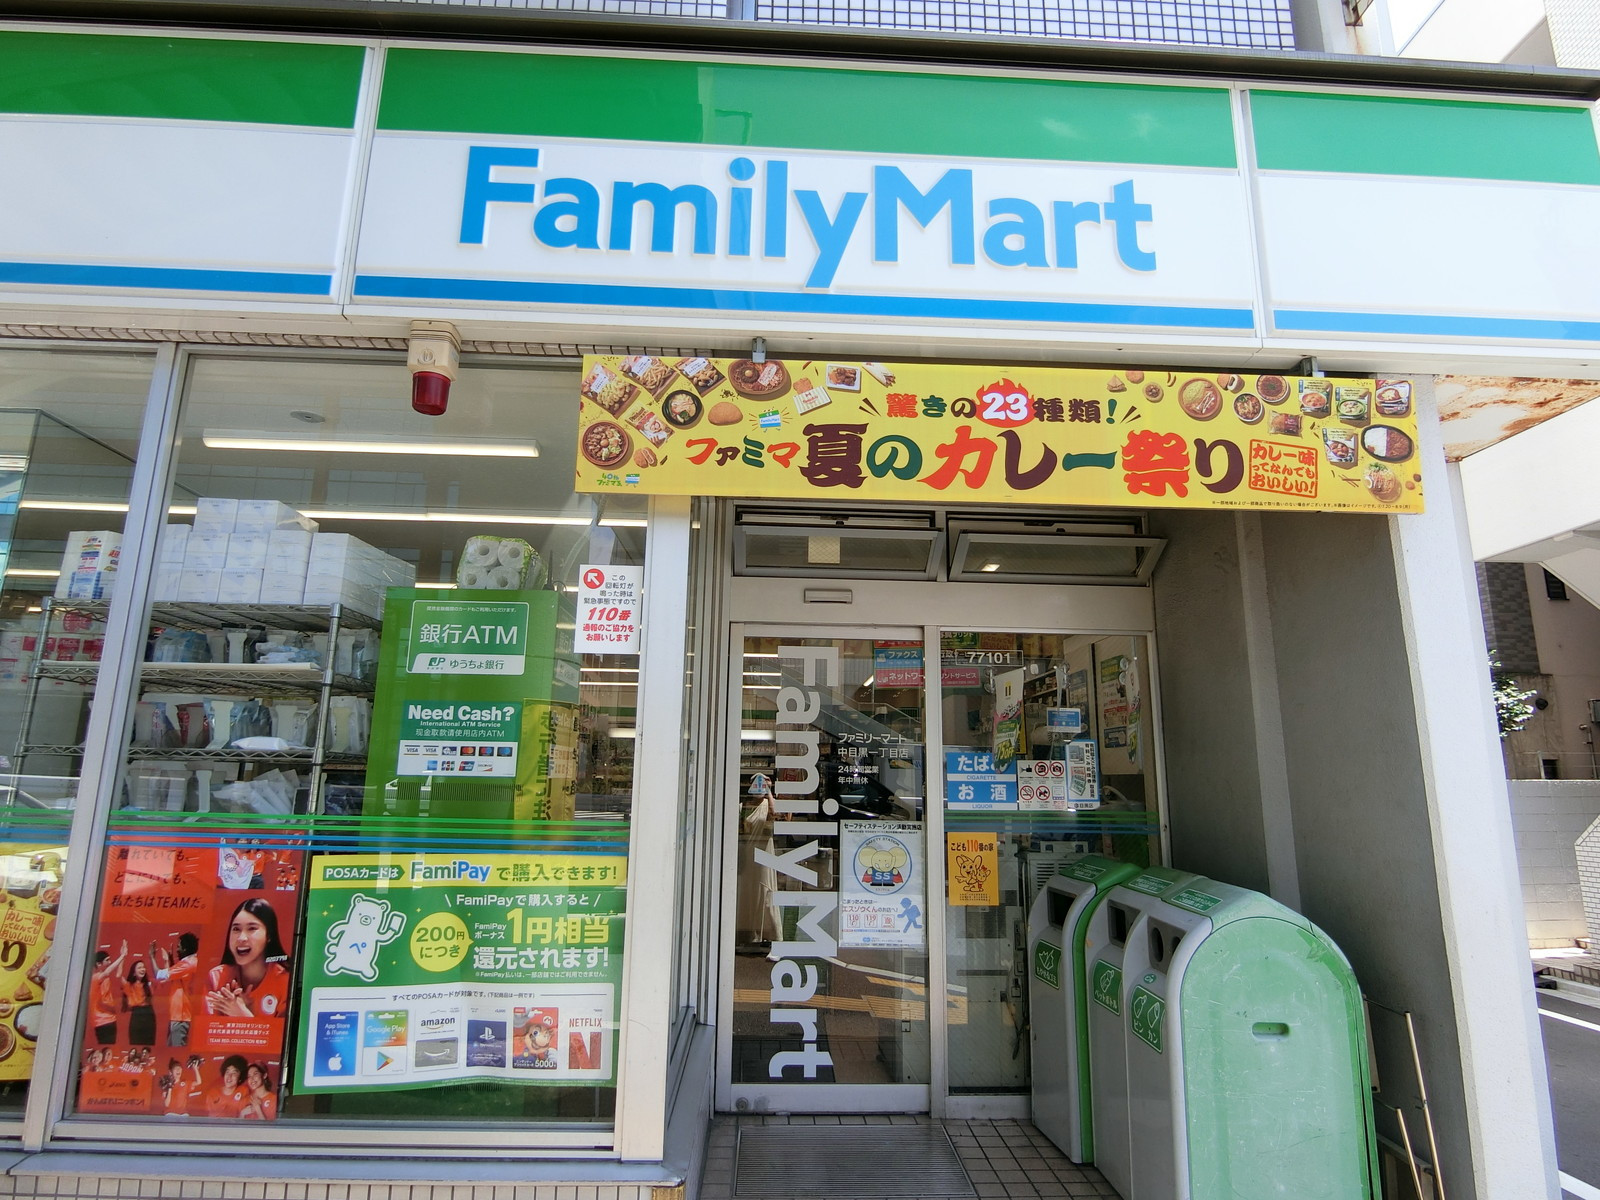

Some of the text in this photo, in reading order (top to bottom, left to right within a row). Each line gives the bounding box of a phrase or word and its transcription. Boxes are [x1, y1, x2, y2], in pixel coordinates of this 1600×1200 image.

[459, 145, 1157, 289] FamilyMart
[886, 391, 1117, 424] 驚きの23種類!
[1252, 443, 1315, 467] カレー味
[1252, 463, 1315, 480] ってなんでも
[1251, 473, 1315, 494] おいしい!
[588, 608, 632, 621] 110番
[420, 624, 518, 645] 銀行ATM
[586, 634, 630, 642] お願いします
[449, 660, 505, 670] ゆうちょ銀行
[967, 652, 1010, 664] 77101
[408, 704, 514, 721] Need Cash?
[838, 733, 907, 744] ファミリーマート
[838, 747, 909, 758] 中目黒一丁目店
[754, 646, 839, 1078] FamilyMart
[326, 861, 617, 882] POSAカードは FamiPay で購入できます!
[111, 895, 206, 909] 私たちはTEAMだ。
[456, 894, 590, 907] FamiPayで購入すると
[6, 912, 42, 926] カレー味
[507, 908, 609, 944] 1円相当
[475, 922, 507, 932] FamiPay
[416, 926, 465, 943] 200円
[475, 931, 505, 940] ボーナス
[420, 944, 460, 958] につき
[473, 946, 609, 970] 還元されます!
[421, 1017, 455, 1026] amazon
[569, 1018, 602, 1028] NETFLIX
